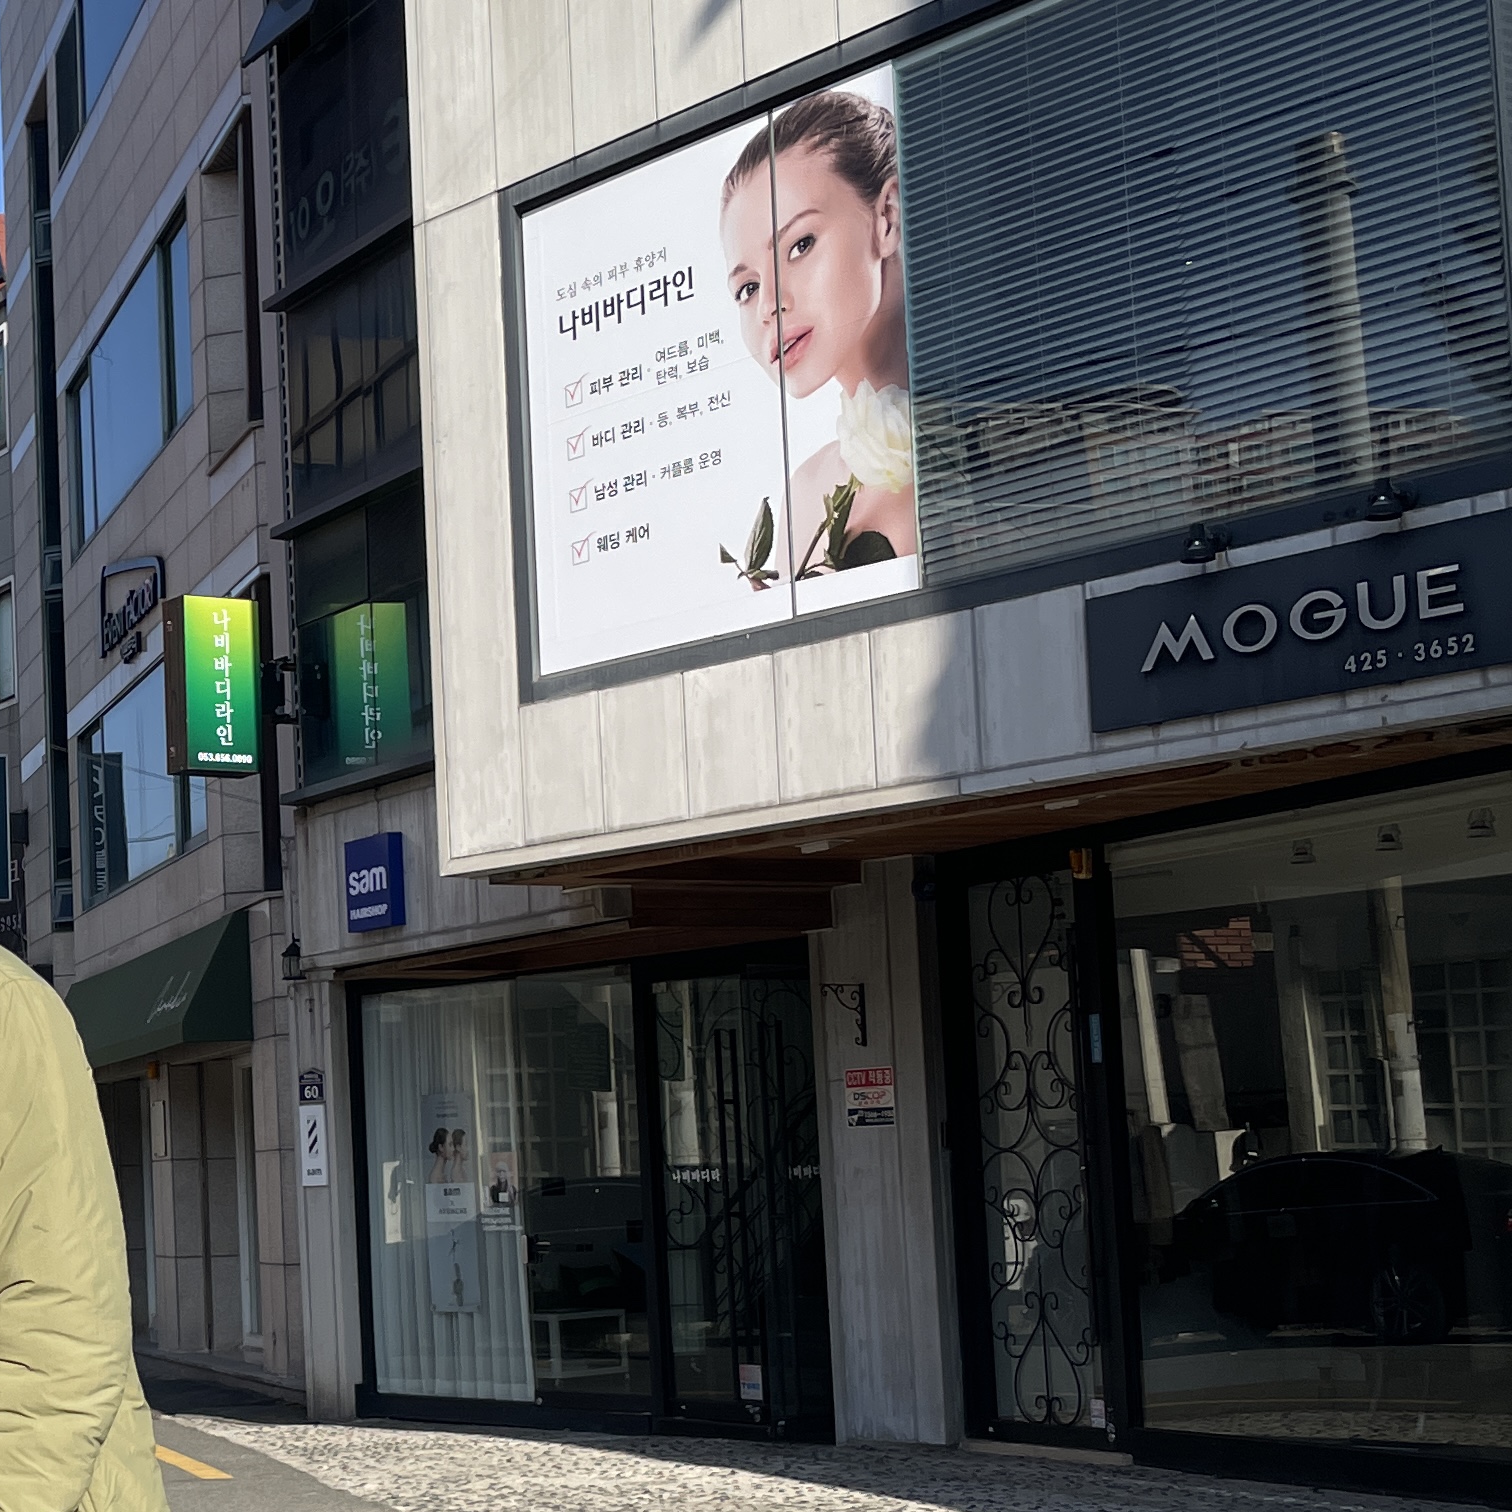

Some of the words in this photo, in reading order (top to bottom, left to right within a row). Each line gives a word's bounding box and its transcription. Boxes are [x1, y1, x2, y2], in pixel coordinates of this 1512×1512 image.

[556, 282, 577, 301] 도심
[581, 271, 603, 292] 속의
[607, 262, 629, 282] 피부
[633, 247, 667, 272] 휴양지
[559, 266, 694, 340] 나비바디라인
[589, 375, 614, 396] 피부
[618, 364, 642, 387] 관리
[686, 355, 710, 375] 보습
[592, 427, 615, 447] 바디
[621, 417, 645, 440] 관리
[707, 391, 731, 412] 전신
[594, 479, 618, 501] 남성
[623, 470, 647, 492] 관리
[698, 449, 722, 469] 운영
[596, 532, 620, 552] 웨딩
[625, 523, 650, 543] 케어
[1141, 563, 1464, 673] MOGUE
[1344, 648, 1387, 673] 425
[1413, 633, 1475, 662] 3652
[212, 608, 234, 746] 나비바디라인
[349, 866, 387, 896] sam
[304, 1085, 319, 1099] 60
